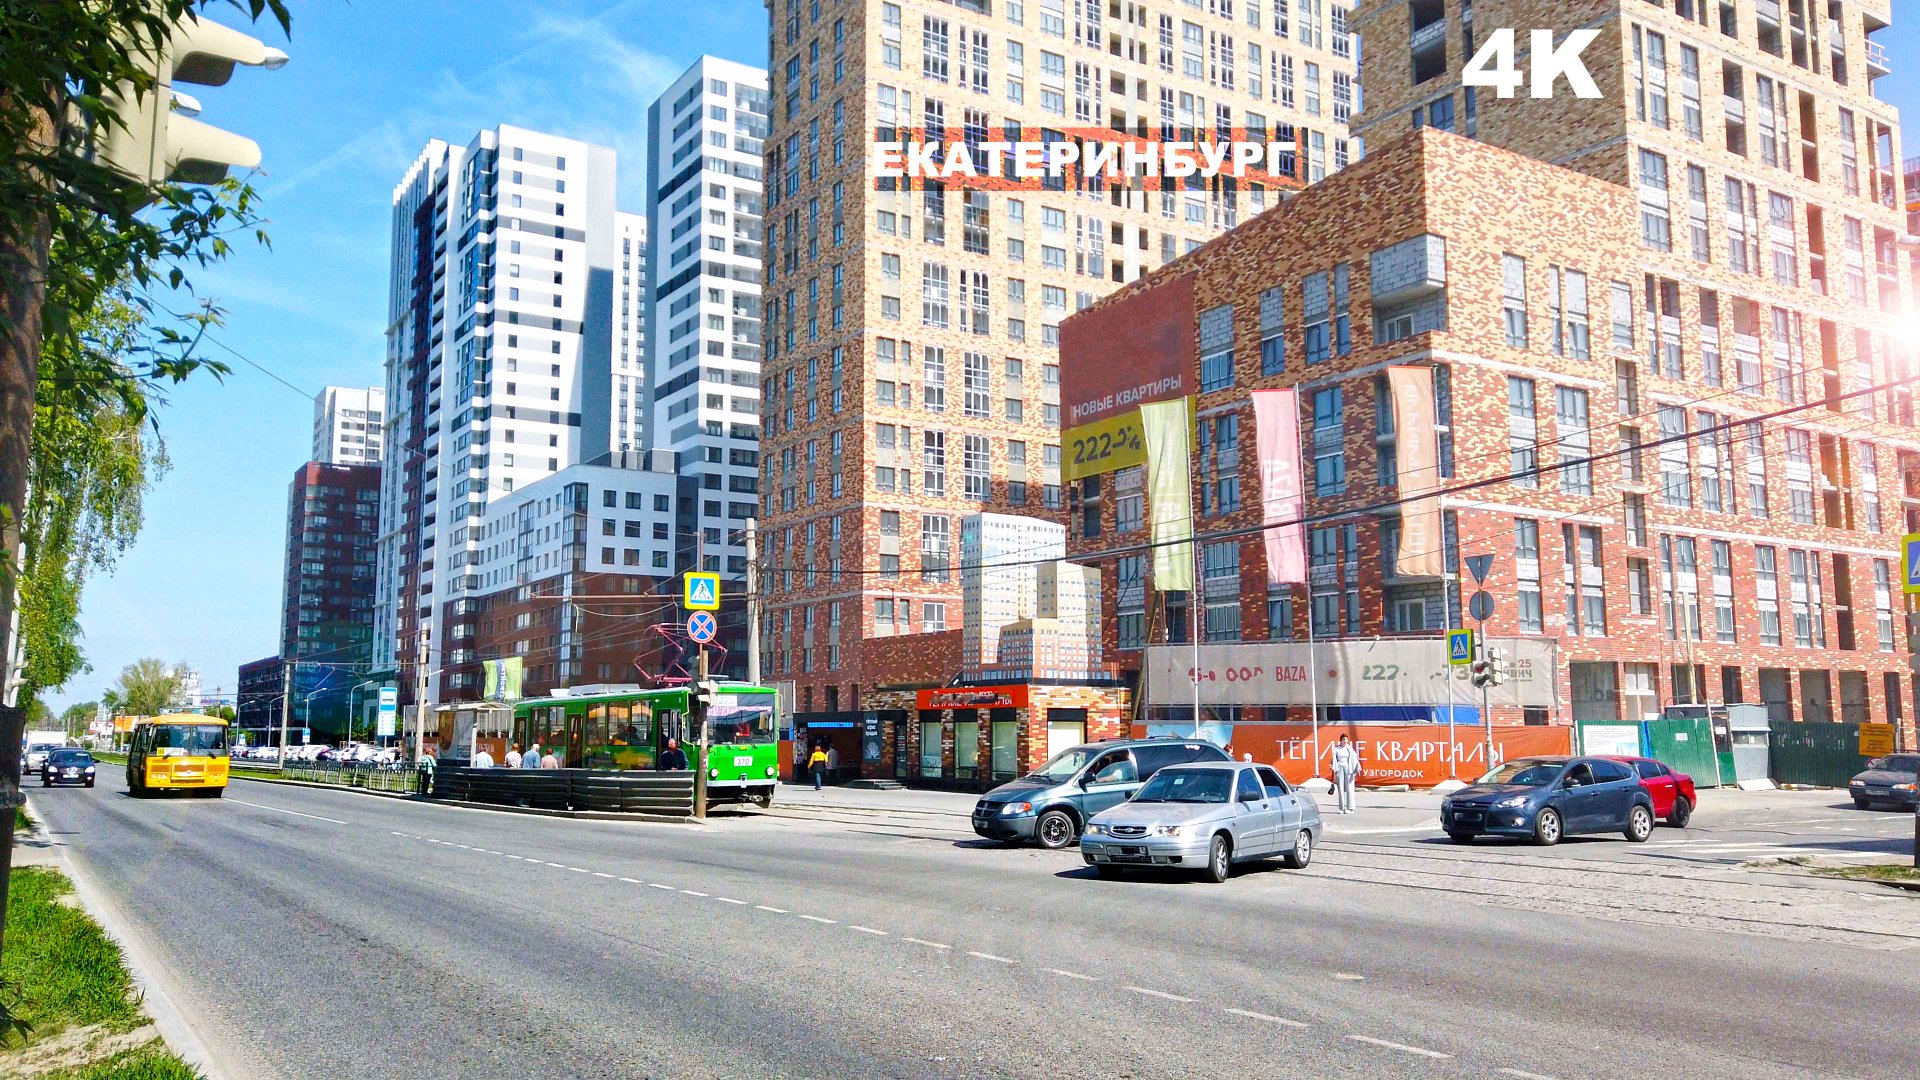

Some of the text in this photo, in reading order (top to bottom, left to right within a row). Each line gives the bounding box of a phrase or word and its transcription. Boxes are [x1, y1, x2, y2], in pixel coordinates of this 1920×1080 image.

[1072, 374, 1182, 419] НОВЫЕ КВАРТИРЫ
[1275, 665, 1307, 682] BAZA
[737, 758, 750, 766] 370
[1358, 768, 1424, 779] УЗГОРОДОК
